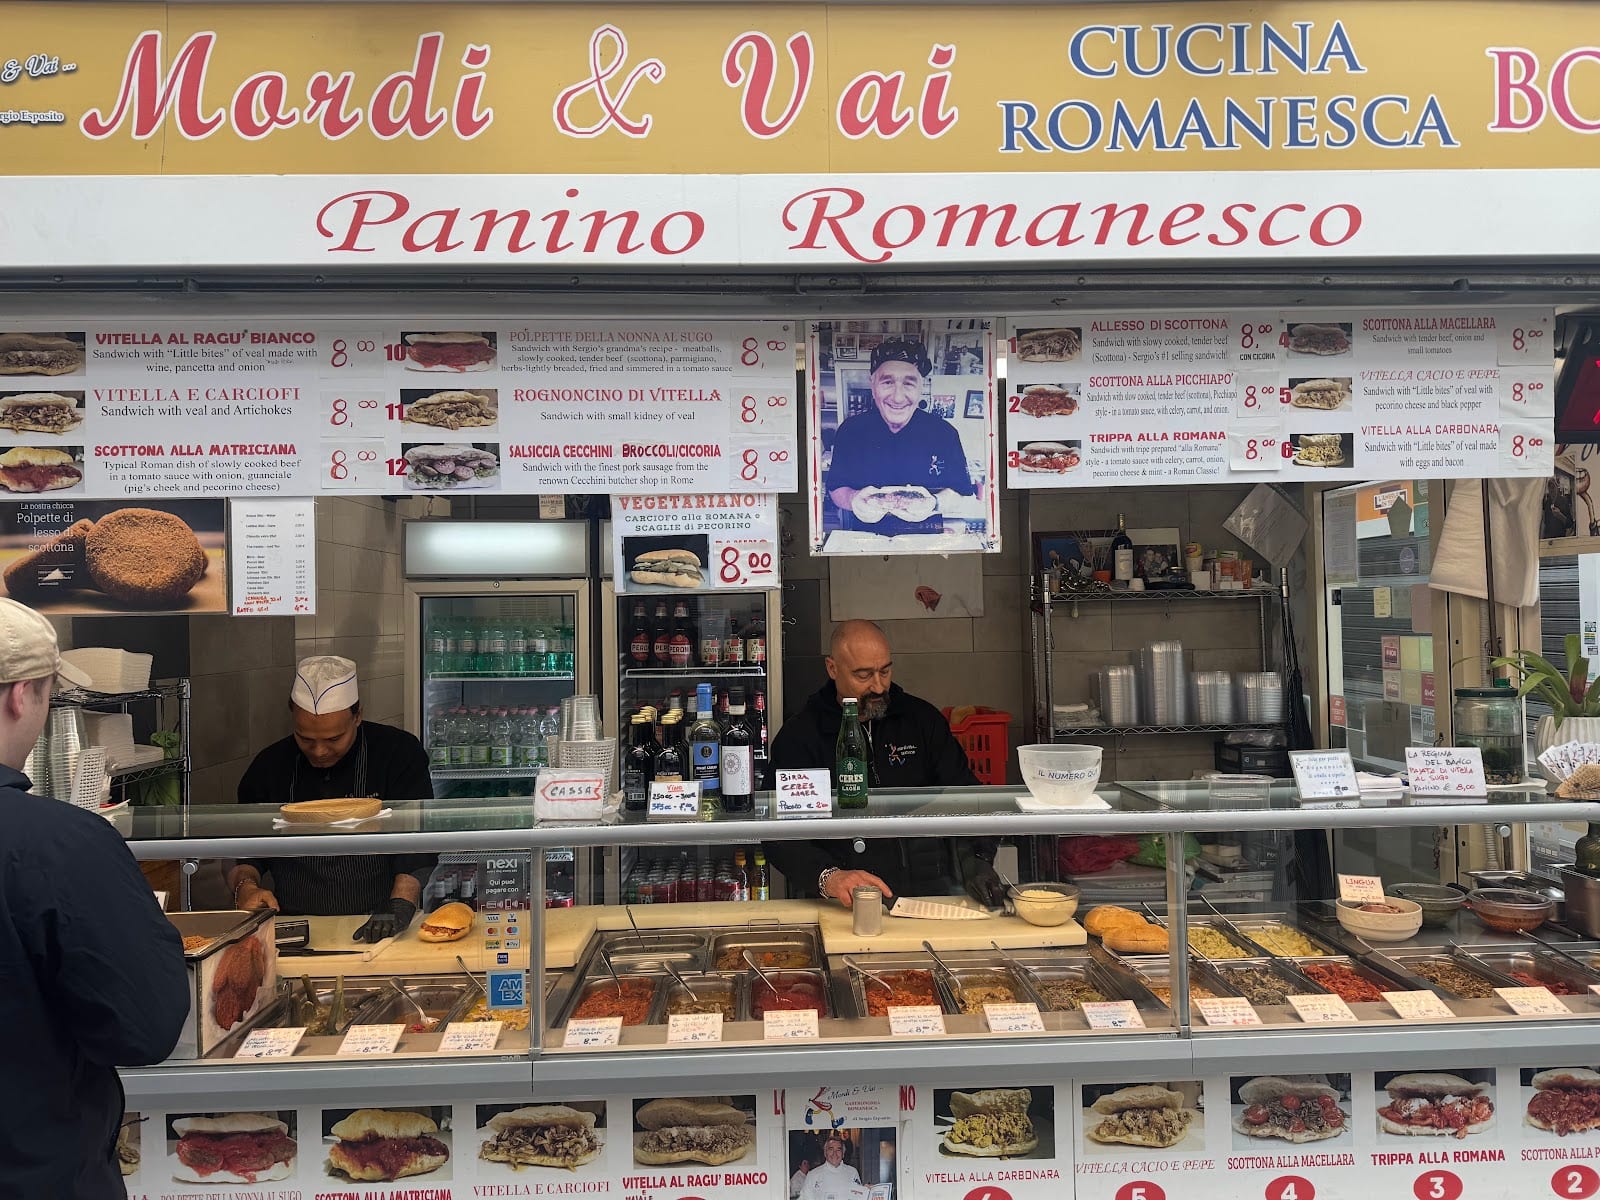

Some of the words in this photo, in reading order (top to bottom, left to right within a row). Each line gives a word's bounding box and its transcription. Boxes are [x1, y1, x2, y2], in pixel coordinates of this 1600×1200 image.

[1068, 20, 1366, 78] CUCINA
[1, 59, 22, 82] &
[25, 53, 59, 77] Vai
[80, 29, 494, 141] Mordi
[553, 23, 666, 138] &
[722, 29, 958, 140] Vai
[20, 110, 65, 124] Esposito
[998, 94, 1460, 153] ROMANESCA
[316, 188, 705, 255] Panino
[782, 187, 1362, 263] Romanesco
[1091, 320, 1144, 331] ALLESSO
[1151, 320, 1161, 330] DI
[1165, 319, 1228, 330] SCOTTONA
[1363, 318, 1412, 331] SCOTTONA
[1414, 318, 1438, 329] ALLA
[1440, 317, 1496, 329] MACELLARA
[96, 333, 163, 344] VITELLA
[167, 333, 189, 344] AL
[194, 331, 246, 345] RAGU'
[251, 332, 315, 344] BIANCO
[509, 331, 572, 341] POLPETTE
[575, 332, 614, 342] DELLA
[618, 332, 660, 342] NONNA
[663, 332, 677, 342] AL
[681, 332, 712, 342] SUGO
[384, 344, 407, 361] 10
[147, 362, 172, 373] wine,
[175, 363, 214, 374] pancetta
[219, 362, 234, 371] and
[239, 363, 264, 371] onion
[1090, 376, 1144, 387] SCOTTONA
[1146, 375, 1173, 386] ALLA
[1176, 373, 1233, 385] PICCHIAPO'
[1360, 370, 1412, 381] VITELLA
[1417, 370, 1453, 381] CACIO
[1456, 370, 1464, 379] E
[1468, 369, 1500, 379] PEPE
[94, 389, 179, 401] VITELLA
[188, 389, 199, 400] E
[206, 388, 299, 400] CARCIOFI
[514, 389, 622, 402] ROGNONCINO
[629, 390, 644, 401] DI
[649, 389, 722, 401] VITELLA
[1279, 387, 1292, 404] 5
[102, 406, 154, 416] Sandwich
[158, 405, 181, 415] with
[186, 405, 207, 415] veal
[211, 405, 230, 415] and
[234, 404, 291, 415] Artichokes
[1009, 396, 1021, 412] 2
[385, 403, 405, 420] 11
[541, 412, 583, 420] Sandwich
[587, 412, 605, 420] with
[608, 412, 631, 420] small
[634, 412, 663, 421] kidney
[678, 412, 694, 420] veal
[1362, 426, 1402, 435] VITELLA
[1406, 425, 1431, 435] ALLA
[1436, 425, 1499, 435] CARBONARA
[1089, 434, 1132, 442] TRIPPA
[1137, 433, 1168, 441] ALLA
[1174, 432, 1226, 440] ROMANA
[95, 445, 164, 456] SCOTTONA
[170, 445, 203, 456] ALLA
[209, 444, 296, 455] MATRICIANA
[510, 445, 560, 457] SALSICCIA
[563, 445, 612, 457] CECCHINI
[1281, 441, 1293, 458] 6
[1008, 451, 1020, 467] 3
[385, 458, 407, 476] 12
[52, 502, 74, 510] chicca
[619, 493, 767, 510] VEGETARIANO!!
[16, 512, 60, 525] Polpette
[63, 512, 74, 523] di
[33, 526, 61, 538] lesso
[28, 543, 74, 552] scottona
[1422, 751, 1452, 759] REGINA
[839, 774, 863, 783] CERES
[1048, 772, 1085, 780] NUMERO
[550, 785, 592, 796] CASSA
[486, 859, 517, 869] nexi
[486, 887, 507, 895] pagare
[500, 980, 522, 990] AM
[503, 990, 522, 1000] EX
[1371, 1153, 1413, 1165] TRIPPA
[1419, 1152, 1449, 1164] ALLA
[1454, 1150, 1505, 1162] ROMANA
[1521, 1149, 1568, 1161] SCOTTONA
[1570, 1148, 1593, 1159] ALLA
[1076, 1162, 1128, 1174] VITELLA
[1132, 1161, 1168, 1173] CACIO
[1171, 1161, 1179, 1170] E
[1183, 1160, 1215, 1170] PEPE
[1228, 1157, 1274, 1169] SCOTTONA
[1277, 1156, 1299, 1168] ALLA
[1301, 1154, 1354, 1167] MACELLARA
[623, 1176, 666, 1189] VITELLA
[670, 1176, 684, 1187] AL
[687, 1174, 721, 1187] RAGU'
[725, 1172, 767, 1185] BIANCO
[926, 1173, 965, 1183] VITELLA
[969, 1172, 993, 1181] ALLA
[998, 1170, 1059, 1180] CARBONARA
[1567, 1172, 1583, 1193] 2
[474, 1185, 530, 1196] VITELLA
[536, 1184, 543, 1194] E
[549, 1181, 610, 1194] CARCIOFI
[1280, 1182, 1298, 1200] 4
[1430, 1177, 1445, 1199] 3
